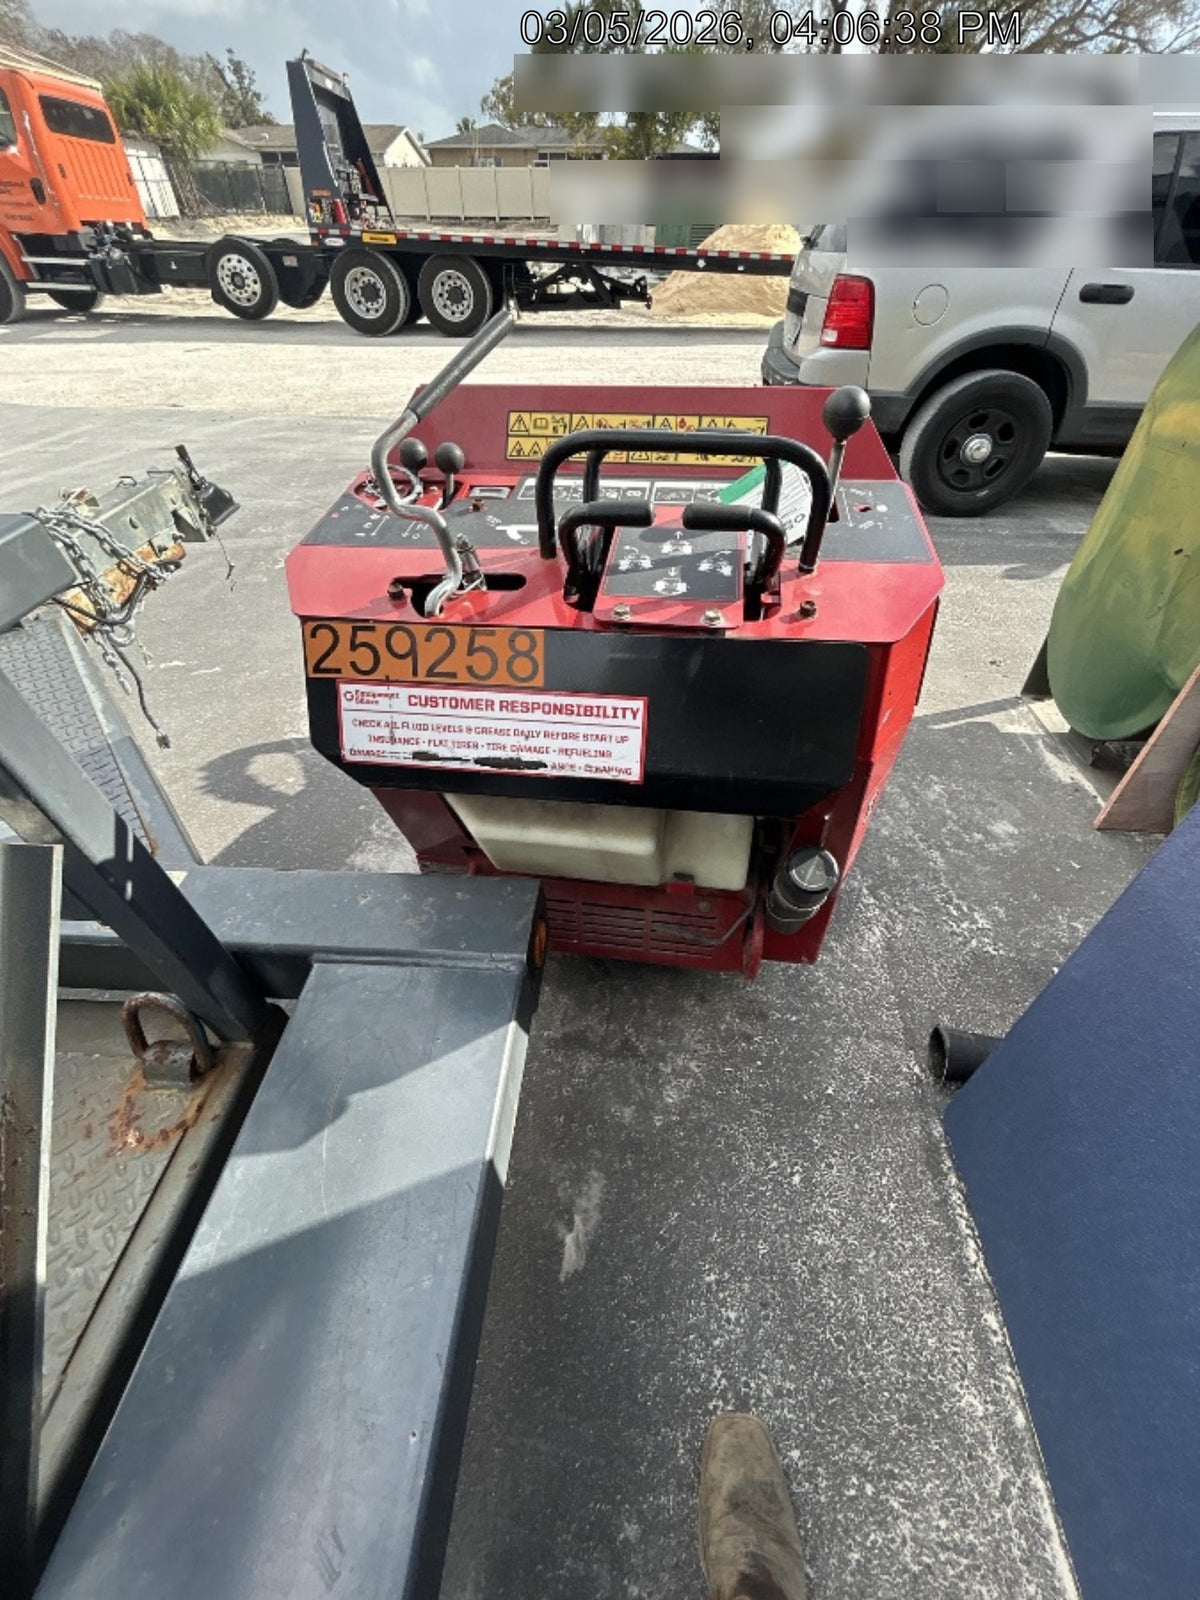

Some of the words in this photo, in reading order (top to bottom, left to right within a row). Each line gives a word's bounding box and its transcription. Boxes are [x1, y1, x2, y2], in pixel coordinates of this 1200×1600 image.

[308, 623, 541, 683] 259258
[408, 694, 495, 712] CUSTOMER
[499, 699, 641, 720] RESPONSIBILITY
[352, 718, 382, 728] CHECK
[402, 721, 429, 732] FLUID
[431, 723, 463, 734] LEVELS
[474, 726, 511, 738] GREASE
[513, 729, 541, 740] DAILY
[543, 731, 580, 742] BEFORE
[583, 734, 613, 744] START
[615, 735, 630, 745] UP
[368, 734, 420, 746] INSURANCE
[452, 740, 479, 751] TIRES
[486, 742, 509, 752] TIRE
[510, 744, 551, 755] DAMAGE
[558, 747, 613, 759] REFUELING
